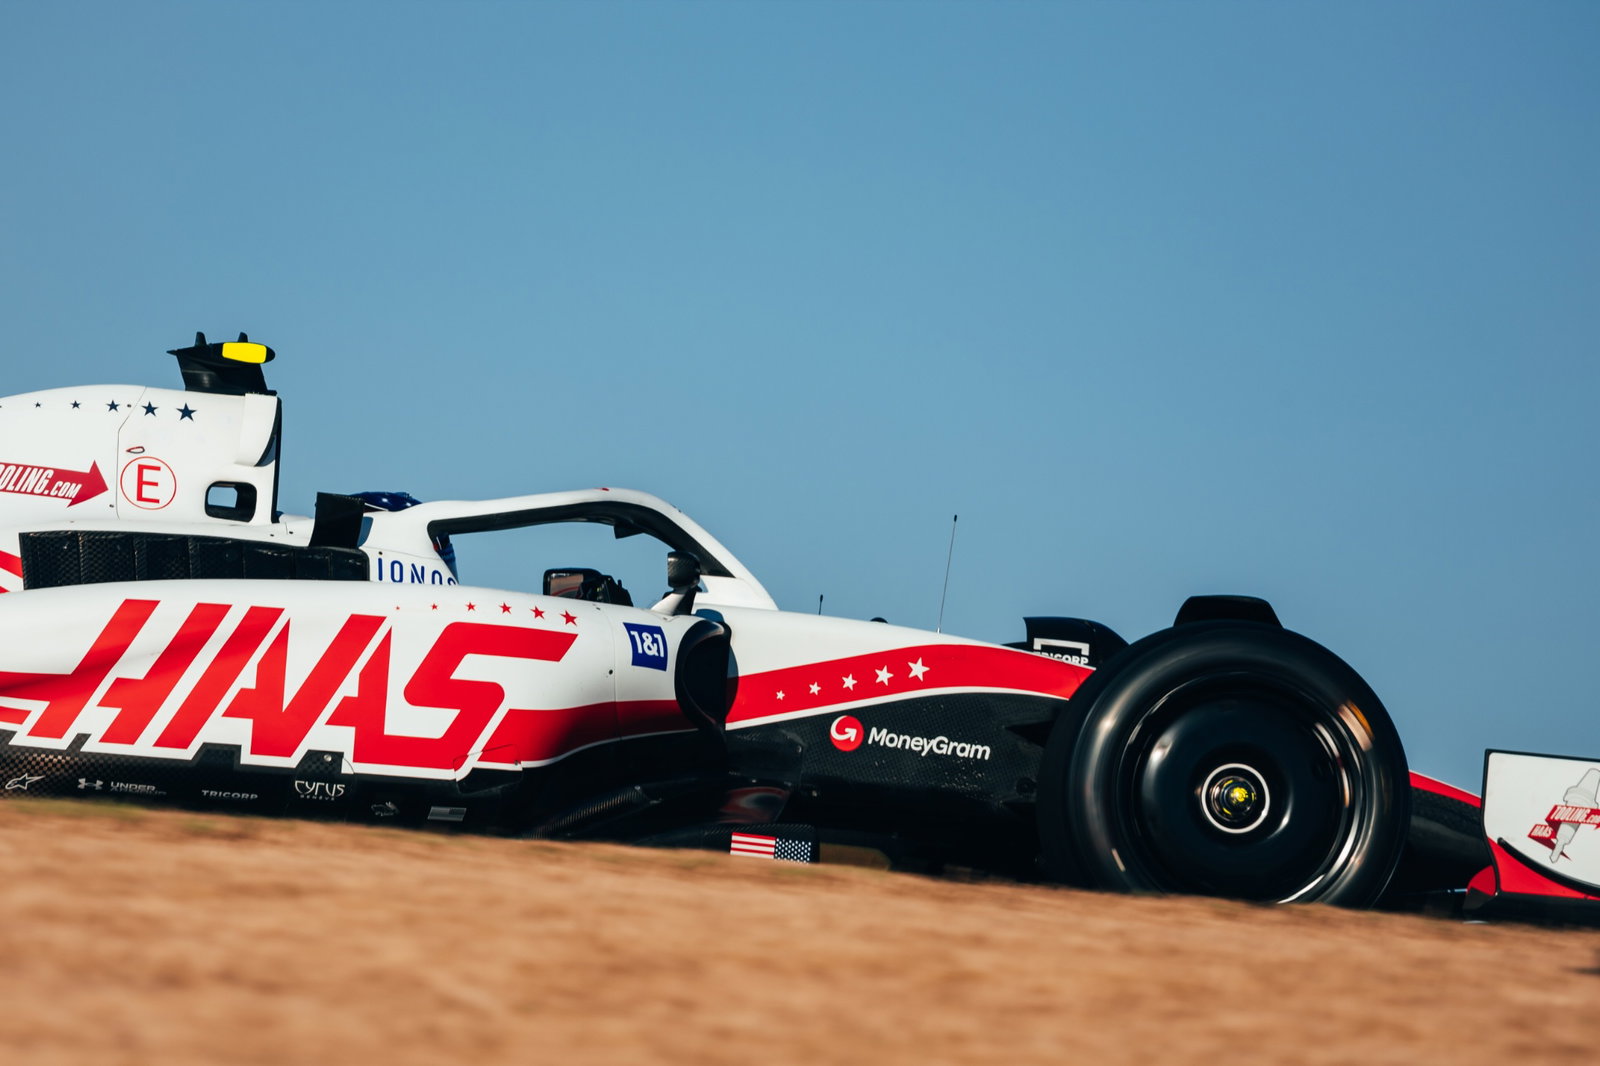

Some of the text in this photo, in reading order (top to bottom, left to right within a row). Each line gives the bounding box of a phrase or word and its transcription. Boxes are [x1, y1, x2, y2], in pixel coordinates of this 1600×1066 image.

[136, 464, 161, 504] E
[378, 557, 456, 585] IONO
[630, 631, 665, 658] 1&1
[27, 598, 578, 770] HAAS
[868, 726, 991, 760] MoneyGram
[110, 781, 156, 792] UNDER
[201, 789, 258, 799] TRICORP
